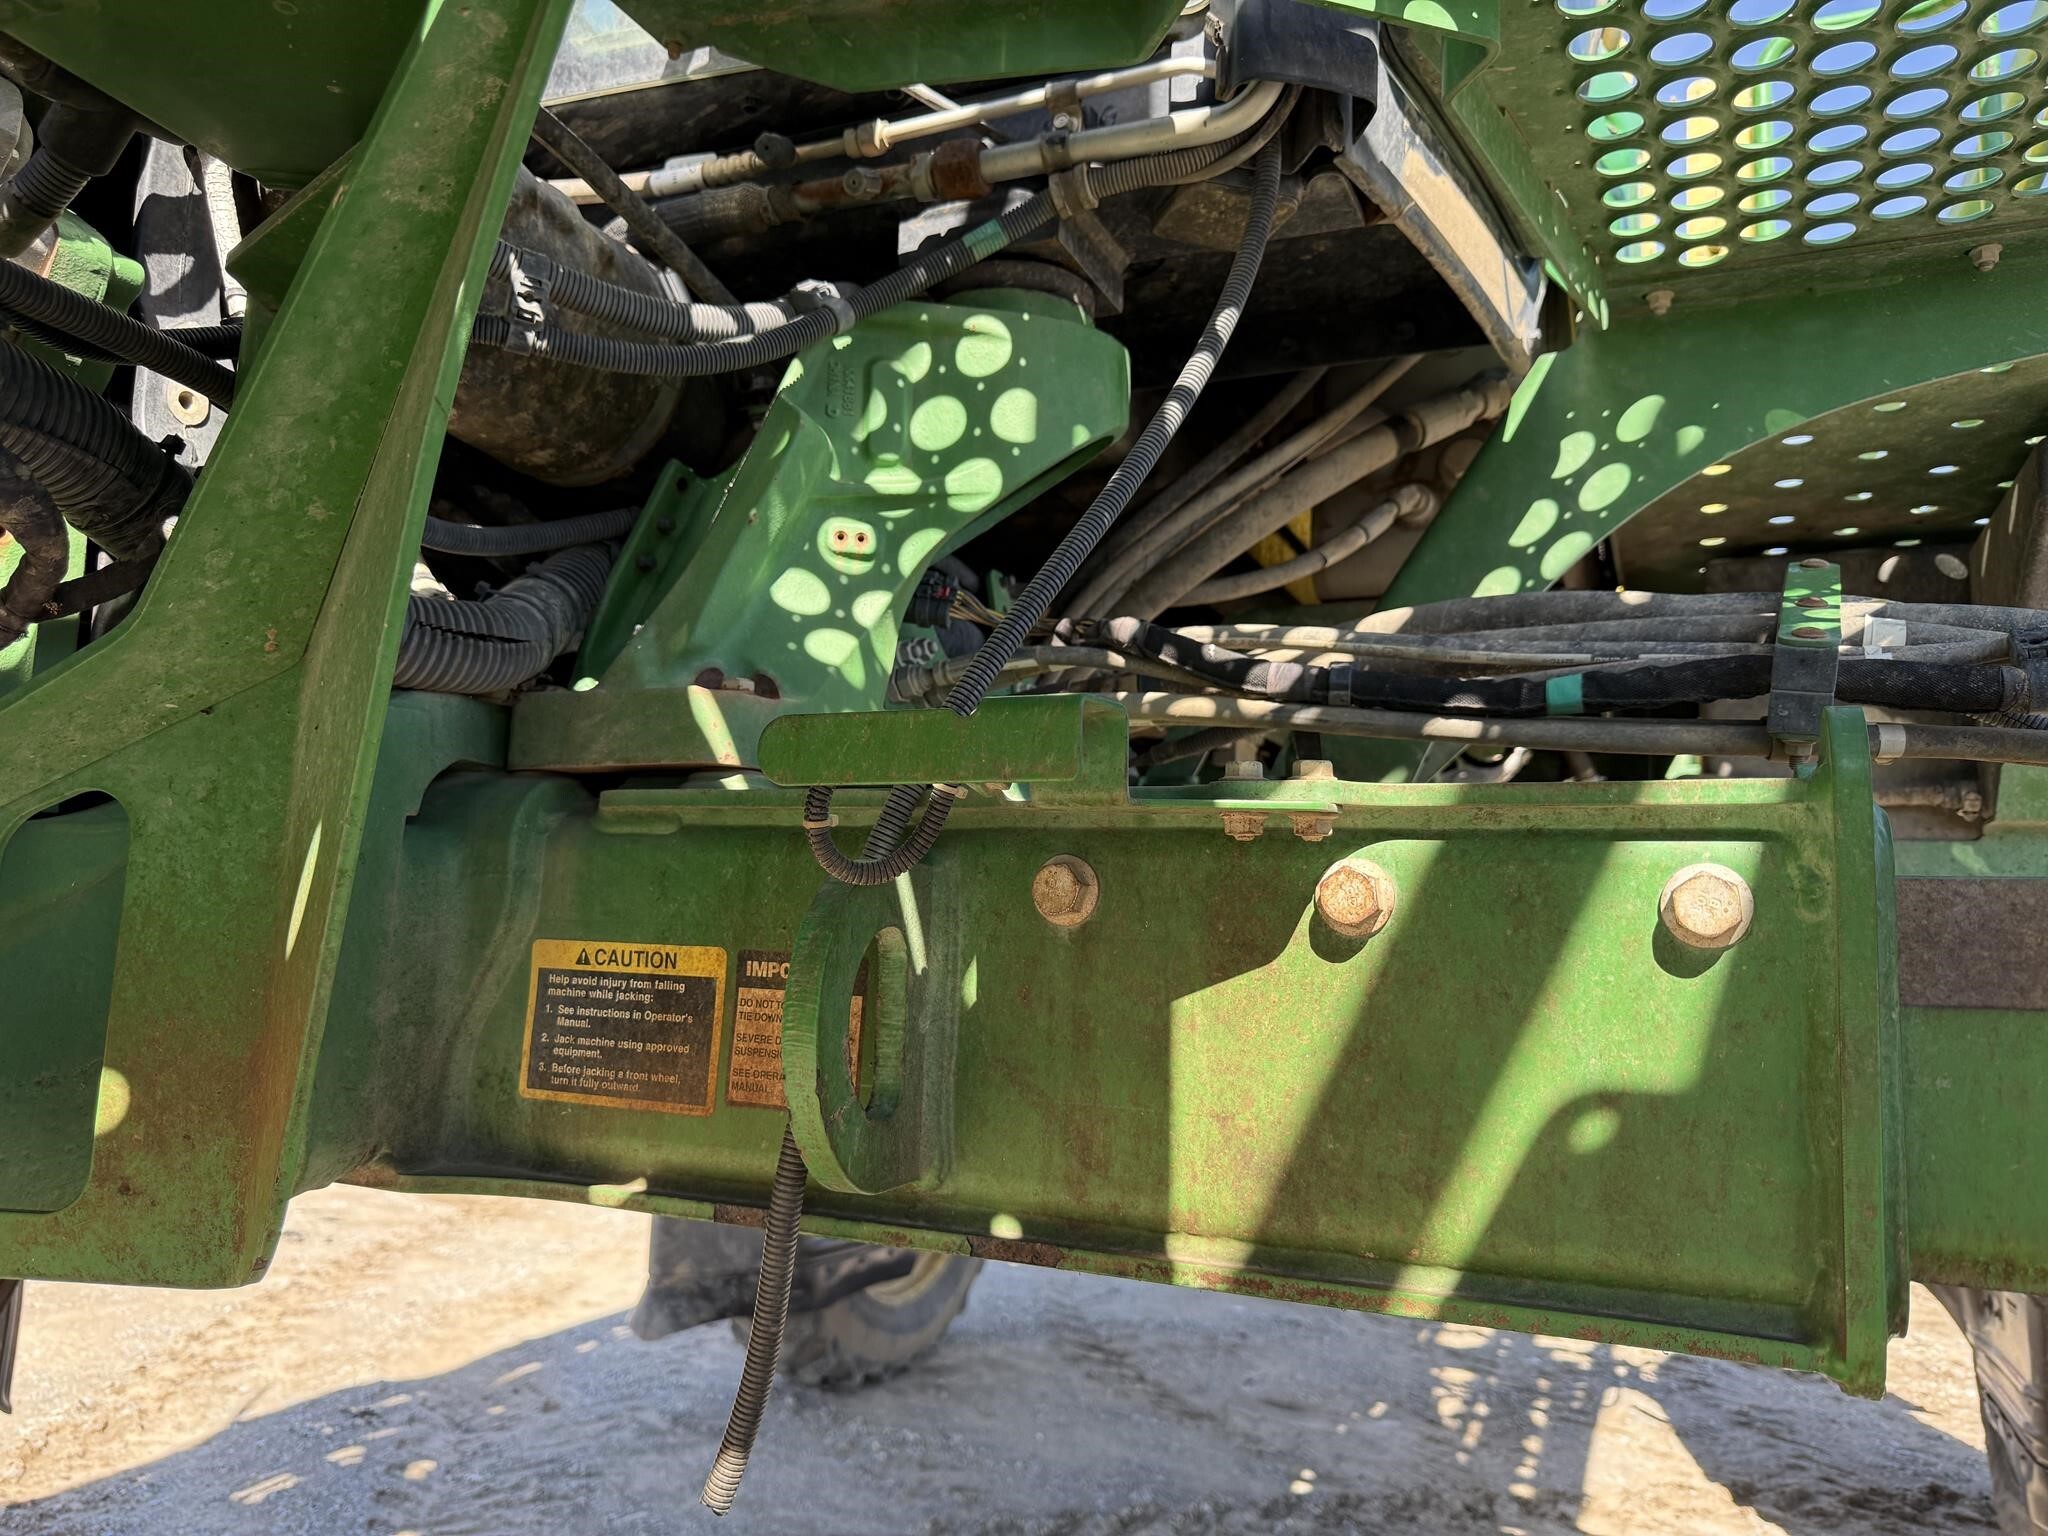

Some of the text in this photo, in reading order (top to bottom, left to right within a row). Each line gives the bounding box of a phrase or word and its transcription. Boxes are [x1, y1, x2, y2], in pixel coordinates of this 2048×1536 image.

[594, 948, 678, 970] CAUTION
[549, 974, 686, 994] Help avoid injury from falling
[548, 987, 654, 1004] machine while jacking:
[740, 998, 754, 1008] DO
[756, 999, 774, 1008] NOT
[545, 1004, 693, 1024] 1. See instructions in Operator's
[738, 1011, 752, 1021] TIE
[556, 1016, 591, 1028] Manual.
[541, 1032, 690, 1054] 2. Jack machine using approved
[736, 1032, 774, 1044] SEVERE
[553, 1046, 603, 1059] equipment.
[538, 1062, 547, 1072] 3.
[552, 1062, 581, 1074] Before
[582, 1065, 616, 1080] jacking
[626, 1070, 648, 1082] front
[650, 1072, 681, 1086] wheel,
[732, 1068, 750, 1078] SEE
[551, 1076, 569, 1086] turn
[571, 1076, 578, 1086] it
[579, 1077, 599, 1090] fully
